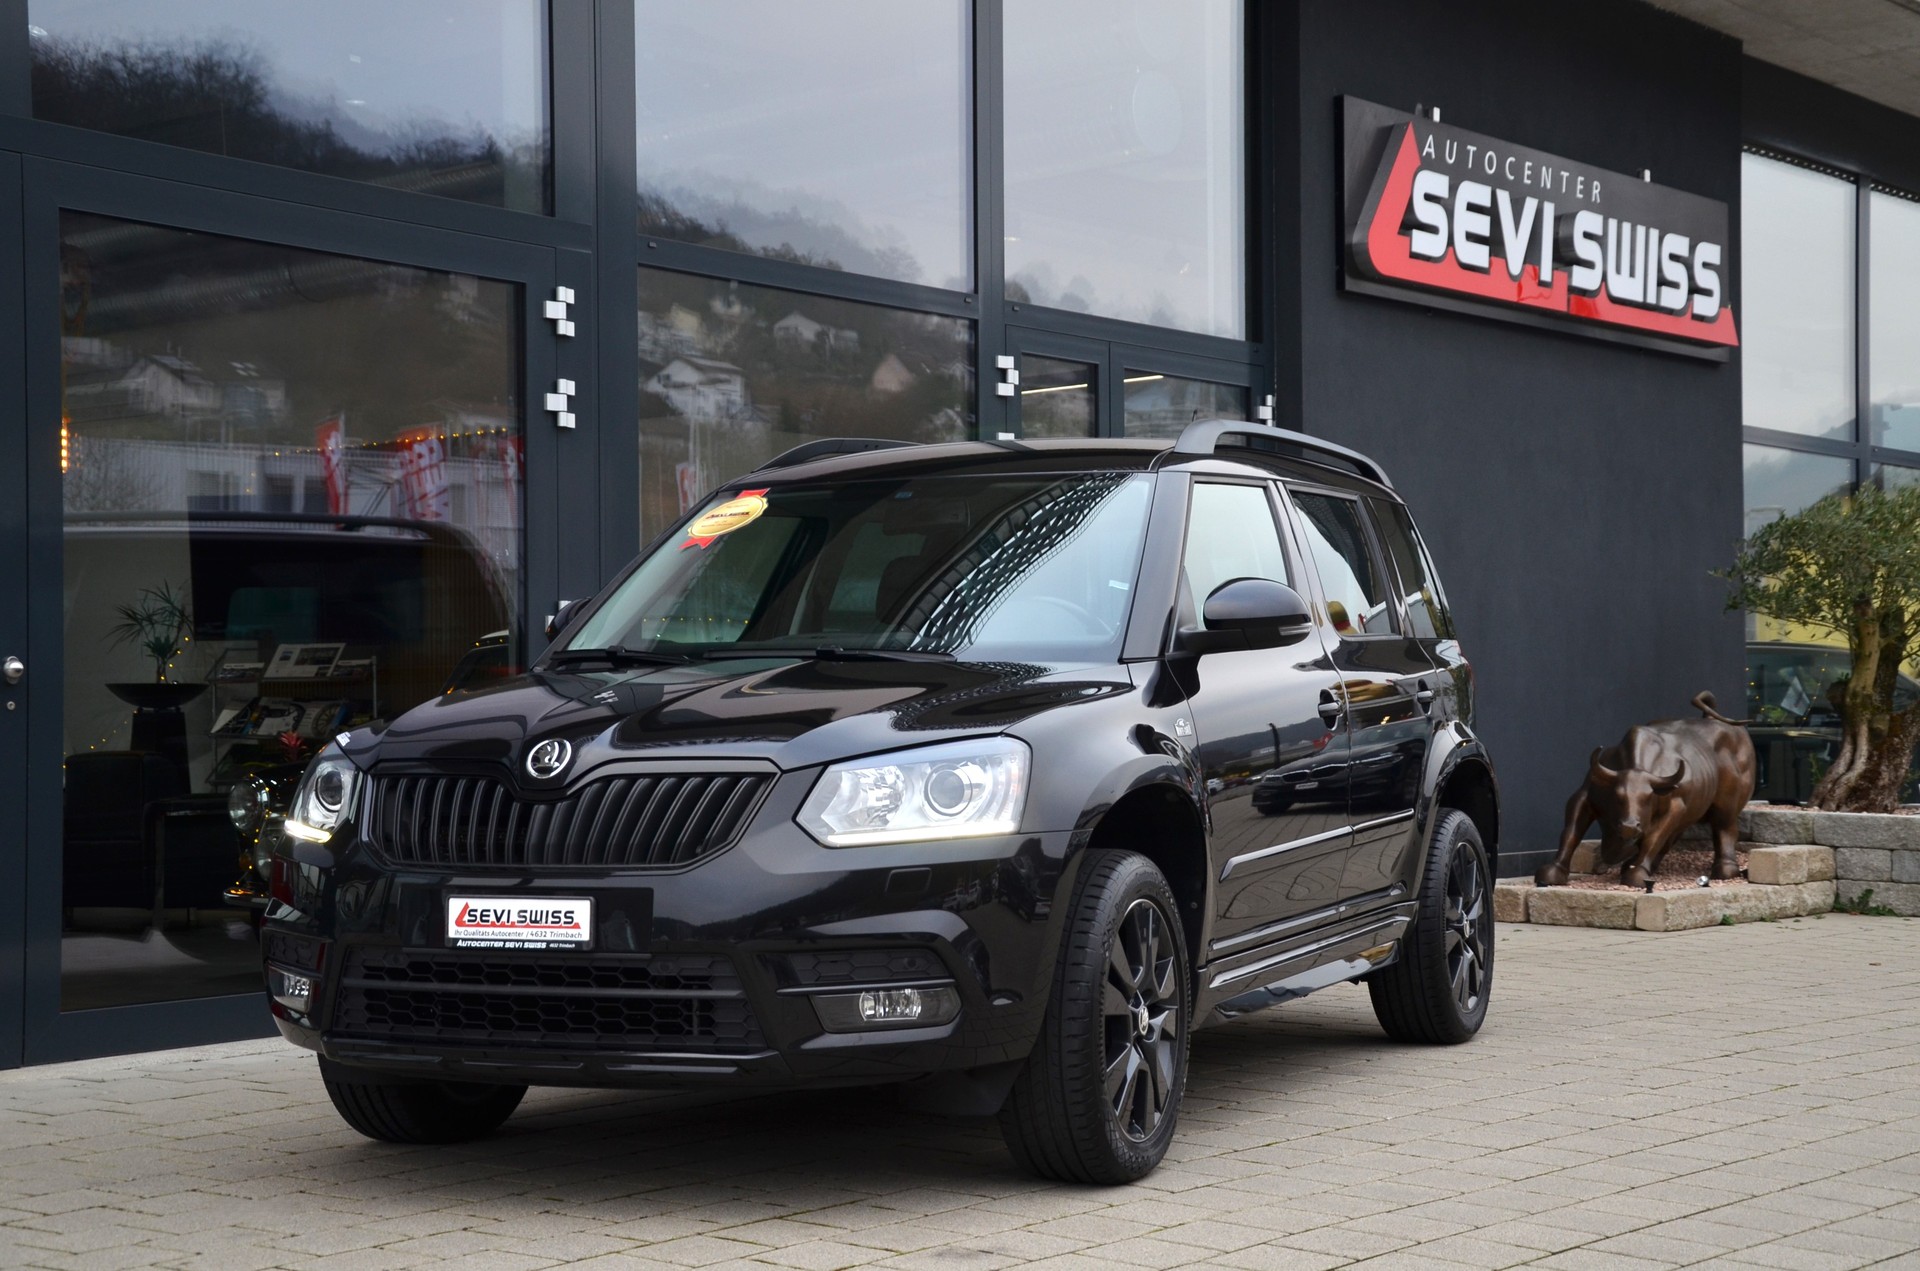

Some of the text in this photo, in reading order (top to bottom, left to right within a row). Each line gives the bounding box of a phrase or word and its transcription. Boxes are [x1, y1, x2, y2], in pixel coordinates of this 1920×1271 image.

[1422, 133, 1602, 204] AUTOCENTER
[1411, 168, 1721, 318] SEVI SWISS
[467, 908, 575, 925] SEVI SWISS
[530, 930, 548, 938] 4632
[550, 931, 582, 939] Trimbach
[457, 939, 504, 948] AUTOCENTER
[505, 941, 523, 949] SEVI
[524, 941, 547, 949] SWISS
